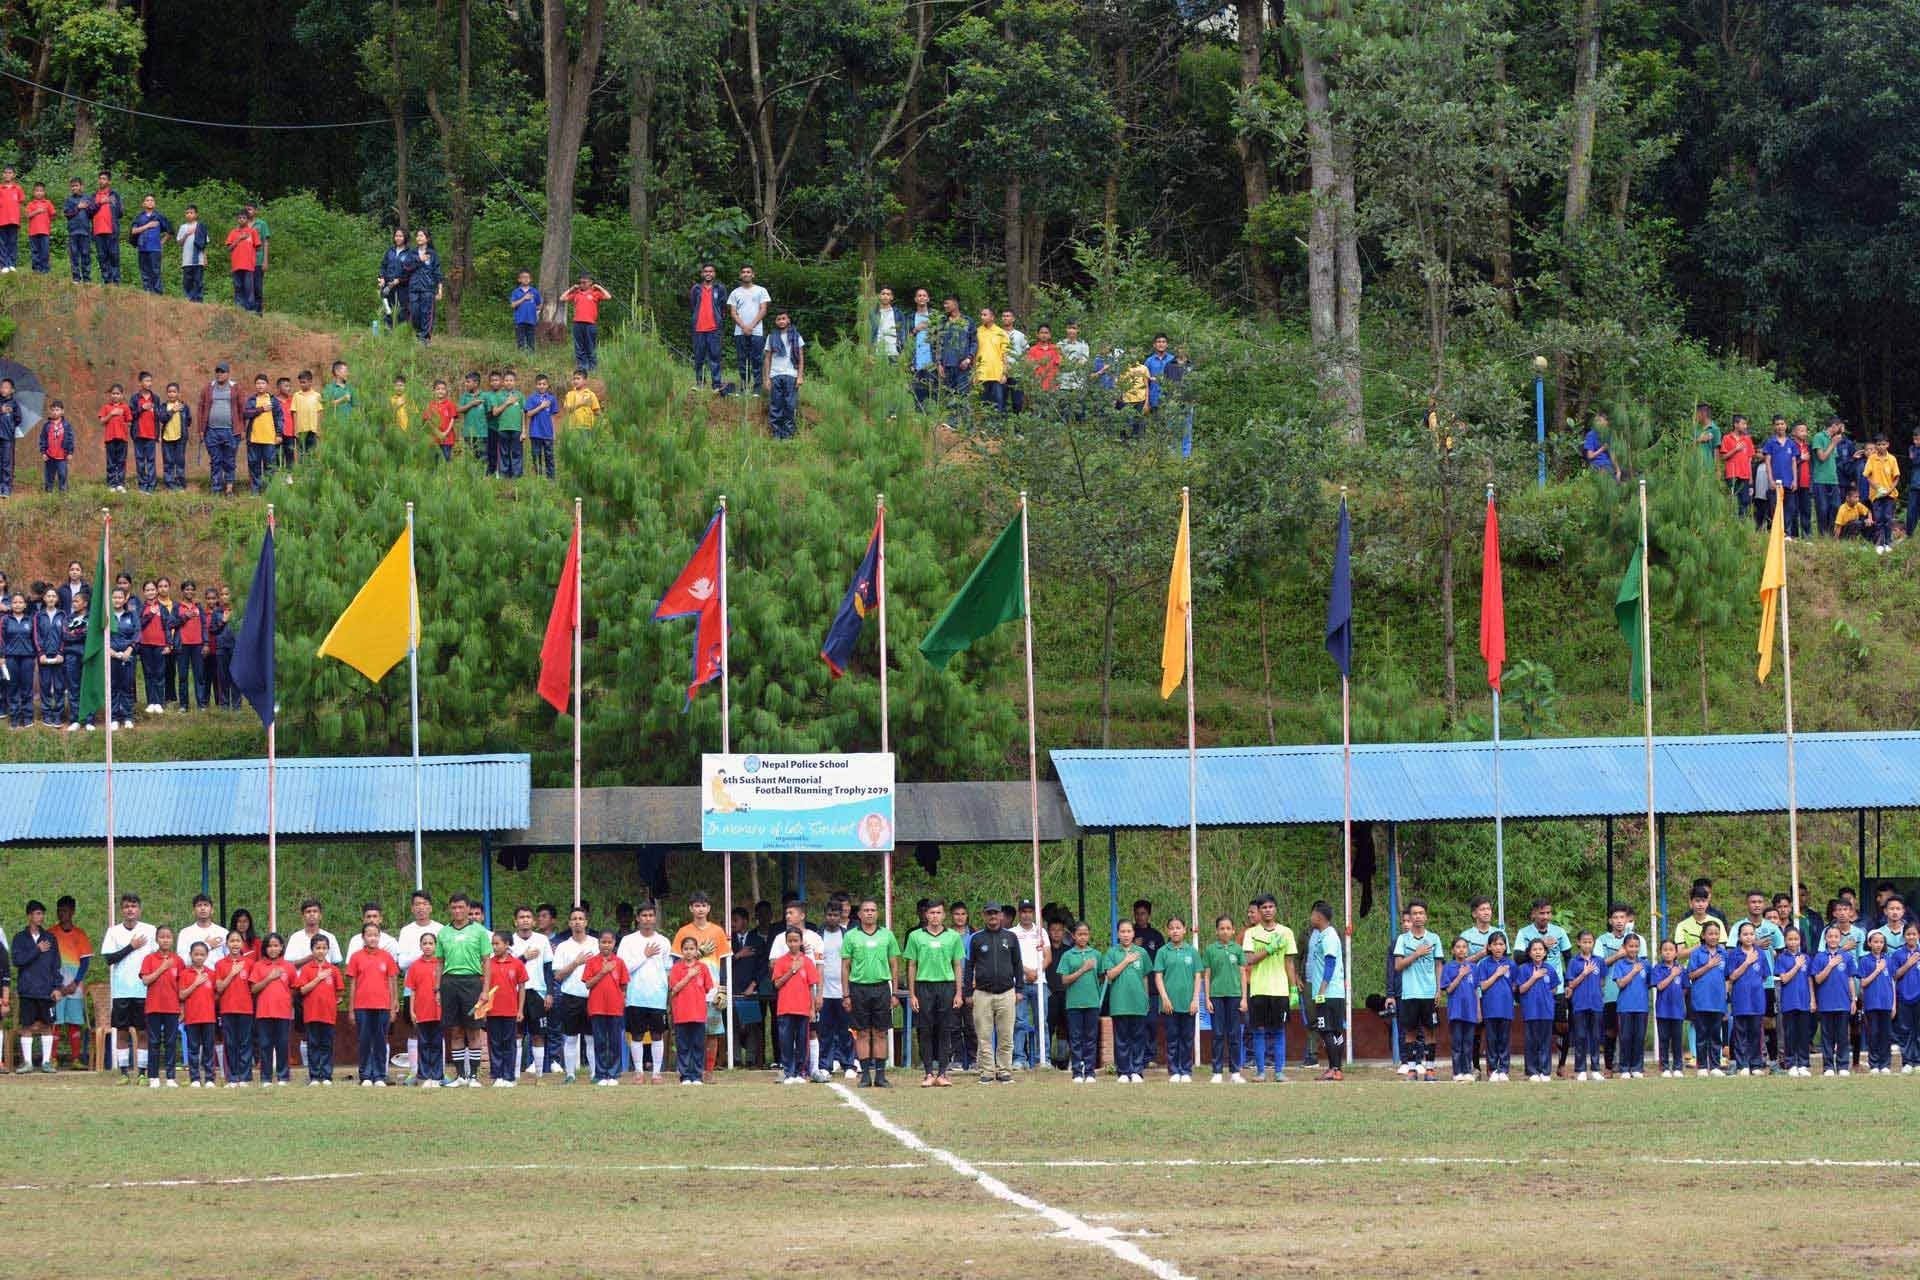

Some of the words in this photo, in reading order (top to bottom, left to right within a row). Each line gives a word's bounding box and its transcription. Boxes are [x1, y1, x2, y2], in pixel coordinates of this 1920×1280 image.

[762, 760, 789, 771] Nepal
[791, 760, 818, 769] Police
[819, 760, 849, 769] School
[723, 776, 738, 784] 6th
[739, 776, 776, 784] Sushant
[778, 776, 821, 784] Memorial
[755, 786, 792, 795] Football
[794, 786, 832, 796] Running
[834, 786, 865, 796] Trophy
[868, 787, 889, 795] 2079
